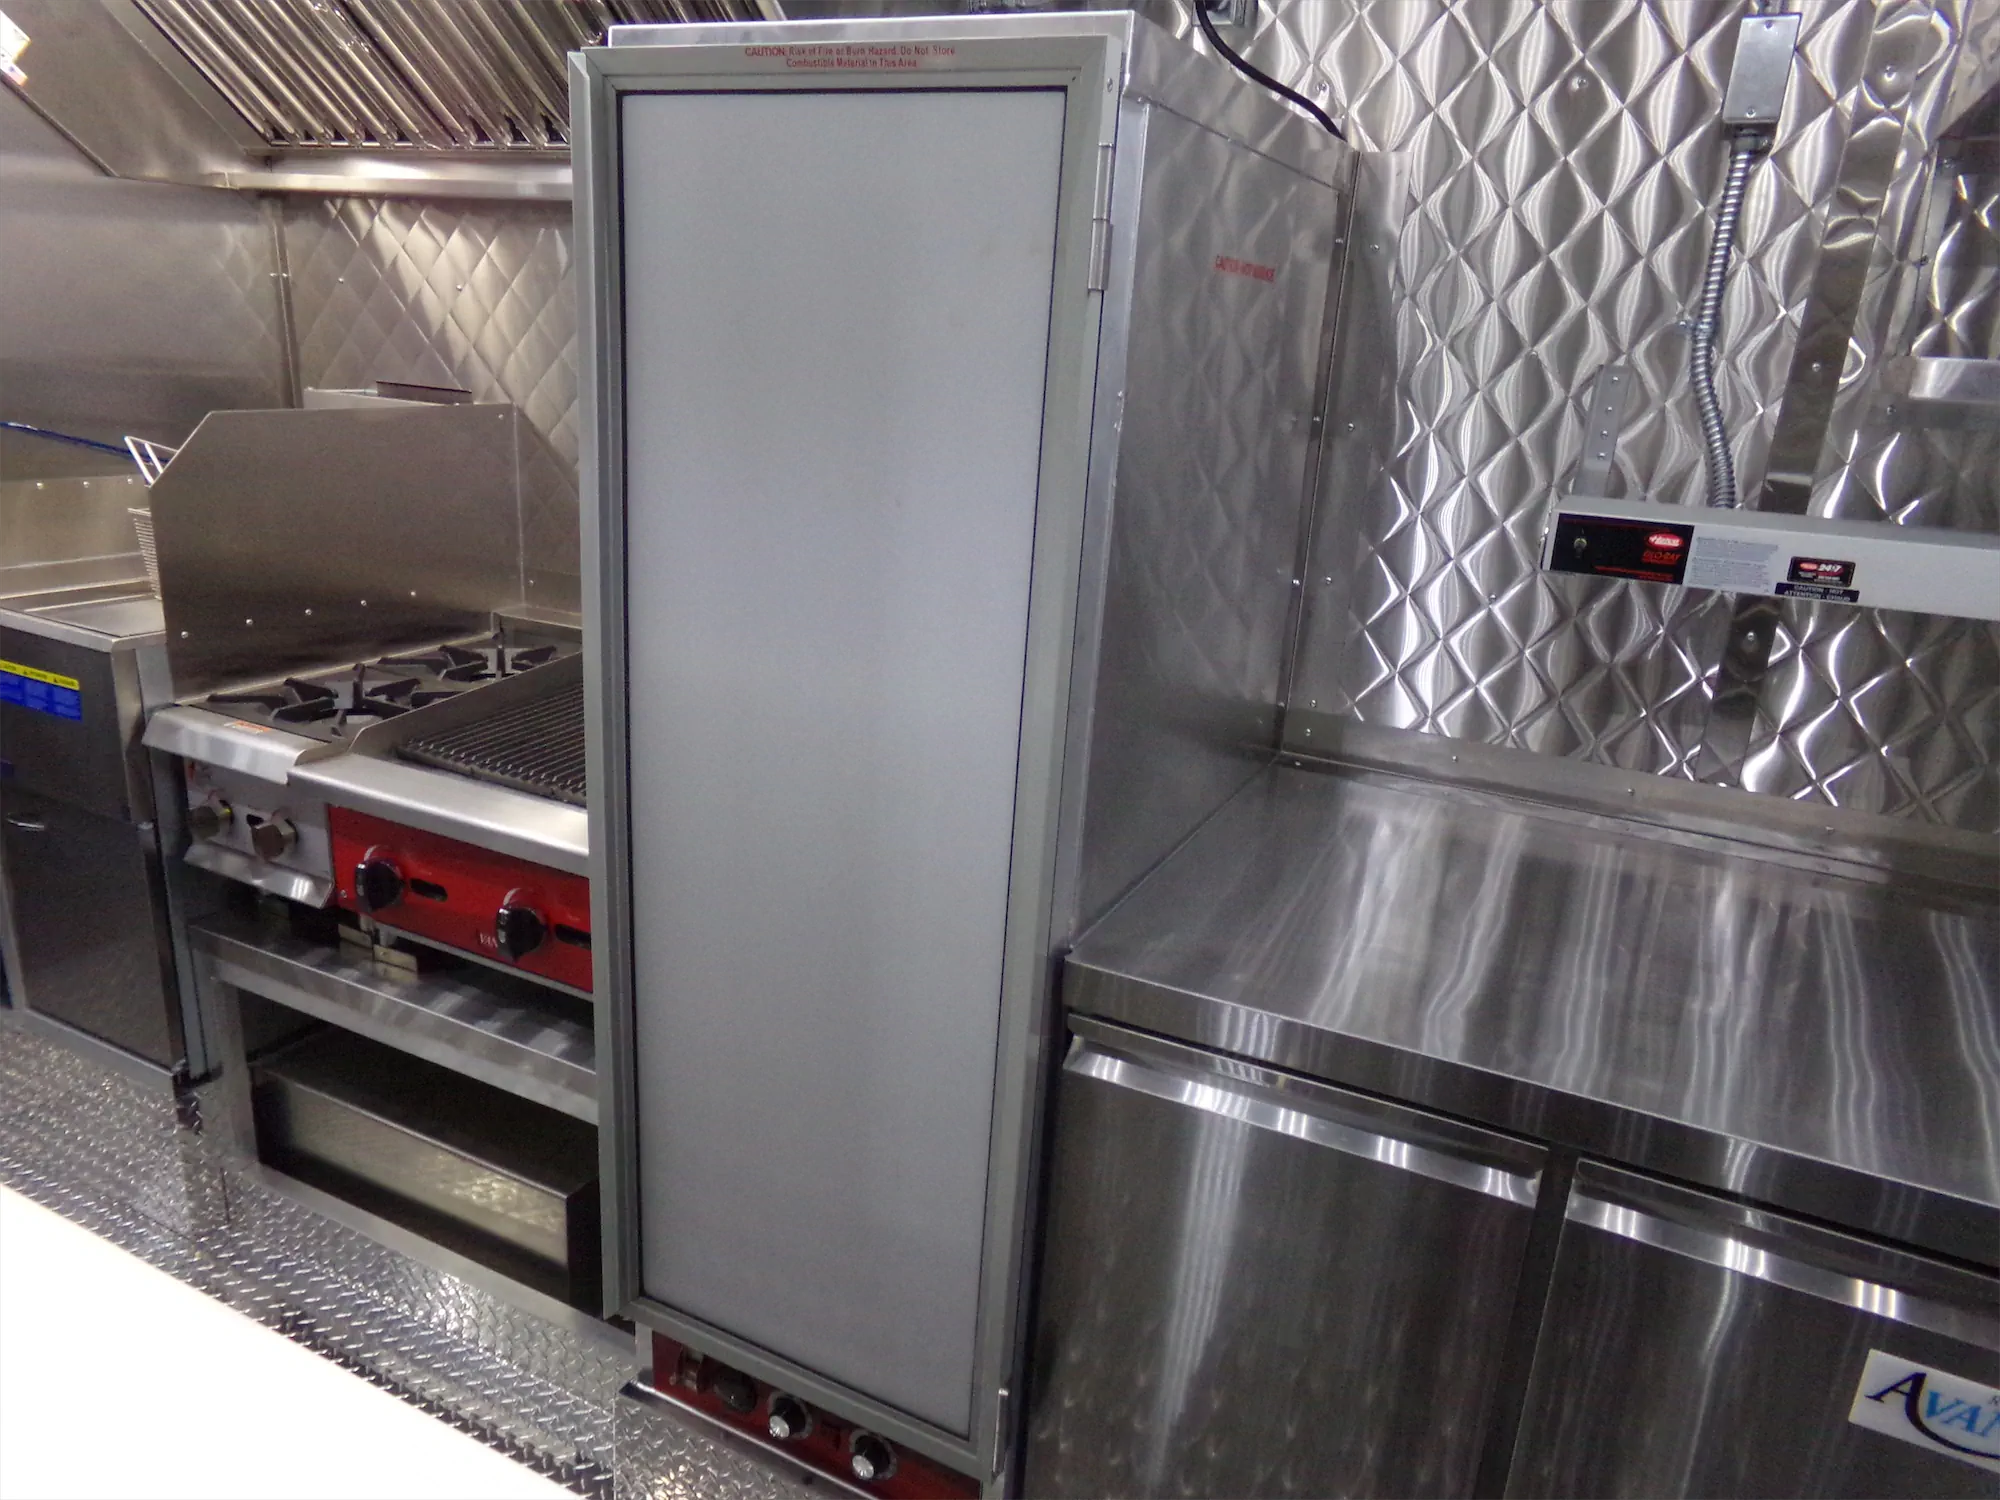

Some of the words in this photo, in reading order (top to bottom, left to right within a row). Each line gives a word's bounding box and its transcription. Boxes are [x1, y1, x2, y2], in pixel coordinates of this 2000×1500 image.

[789, 46, 806, 56] Risk
[846, 46, 865, 56] Burn
[900, 46, 912, 56] Do
[914, 45, 929, 56] Not
[932, 45, 955, 55] Store
[786, 58, 834, 68] Combustible
[836, 57, 869, 68] Material
[879, 57, 897, 67] This
[898, 57, 918, 68] Area
